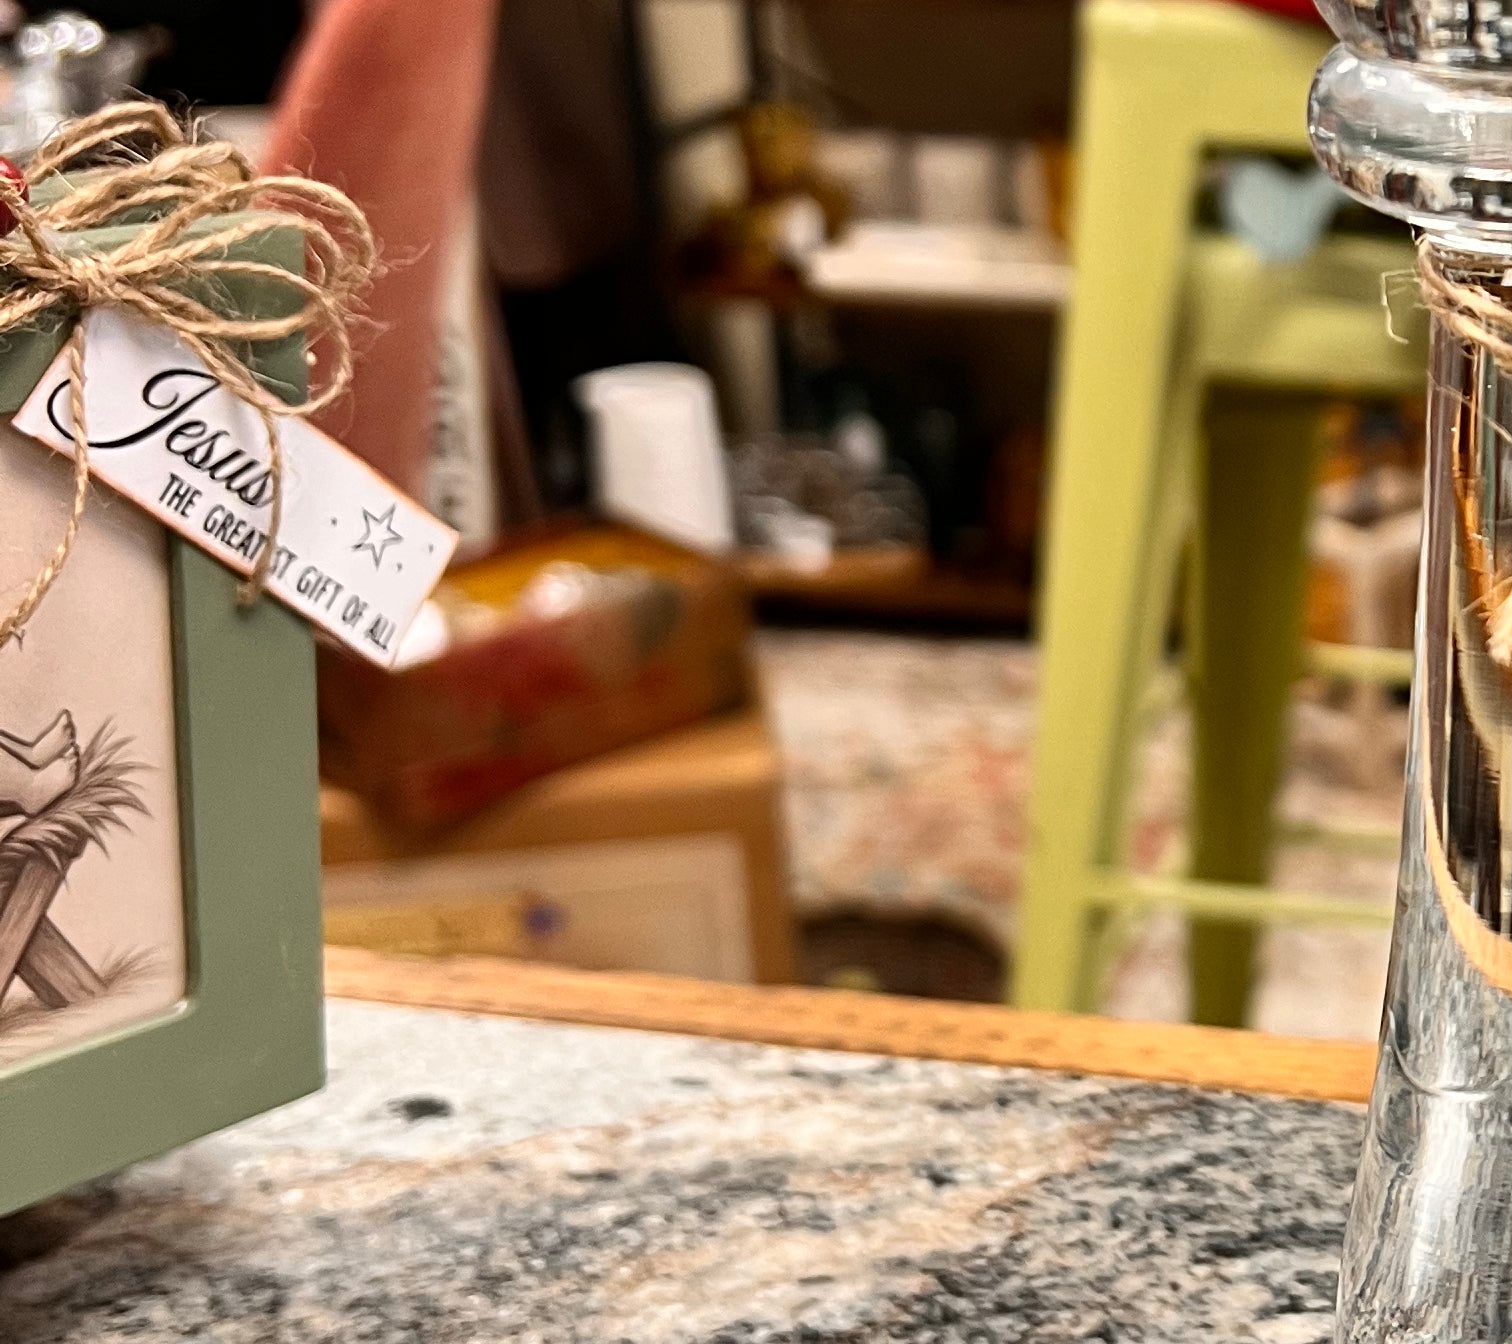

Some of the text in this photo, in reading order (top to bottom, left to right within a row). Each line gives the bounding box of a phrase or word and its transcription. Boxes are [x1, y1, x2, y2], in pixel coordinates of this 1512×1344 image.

[47, 368, 274, 507] Jesus
[158, 472, 398, 650] THE GREATST GIFT OF ALL
